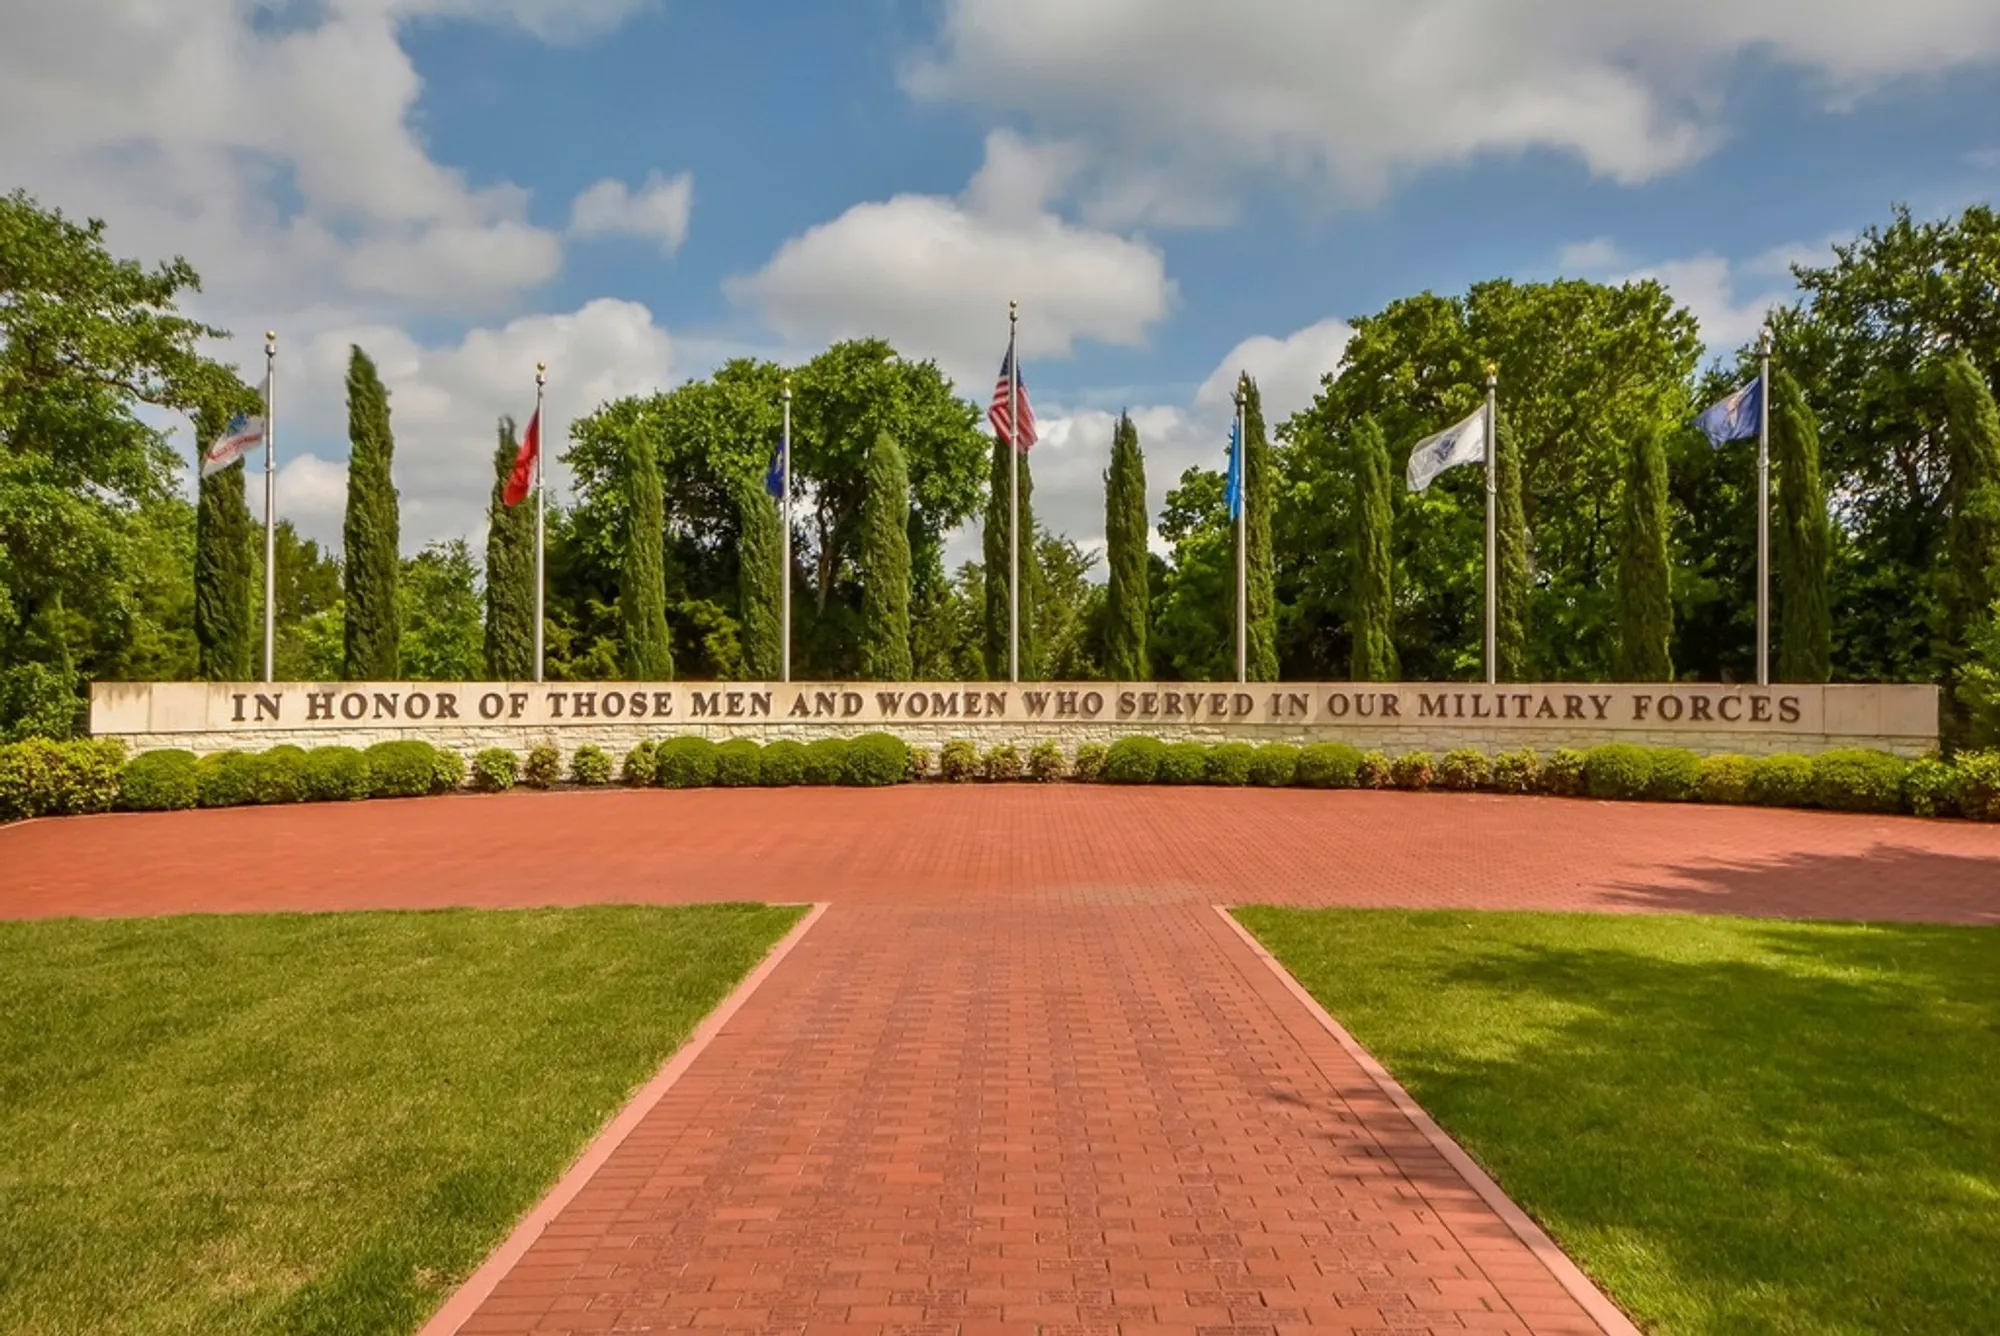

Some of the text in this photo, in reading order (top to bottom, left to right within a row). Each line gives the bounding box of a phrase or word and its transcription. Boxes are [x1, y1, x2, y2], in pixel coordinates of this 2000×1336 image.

[231, 692, 1802, 725] IN HONOR OF THOSE MEN AND WOMEN WHO SERVED IN OUR MILITARY FORCES
